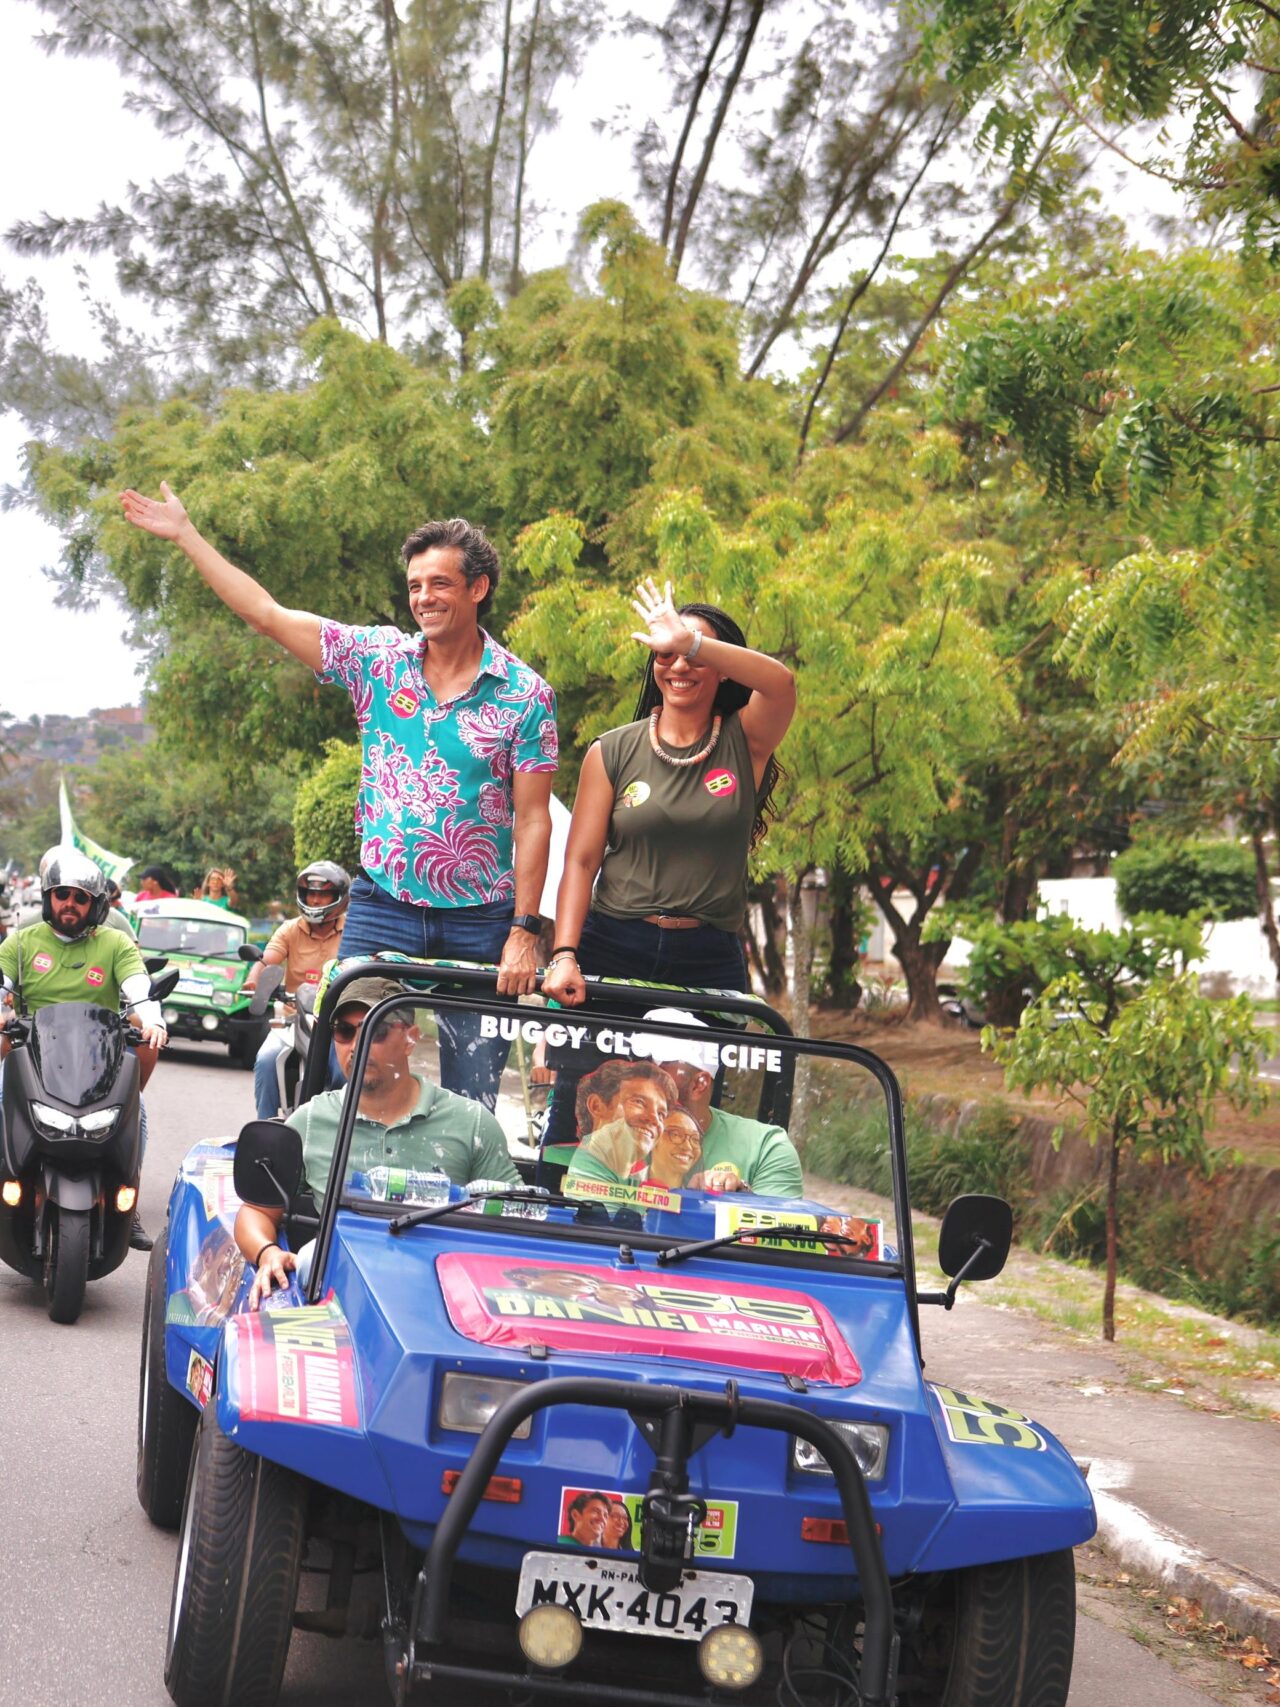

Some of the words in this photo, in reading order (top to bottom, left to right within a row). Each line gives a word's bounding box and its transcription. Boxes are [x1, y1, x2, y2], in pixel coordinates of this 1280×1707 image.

[480, 1015, 588, 1050] BUGGY
[596, 1030, 677, 1062] CLU
[495, 1295, 711, 1334] DANIEL
[635, 1284, 820, 1327] 55
[705, 1316, 827, 1345] MARIAN
